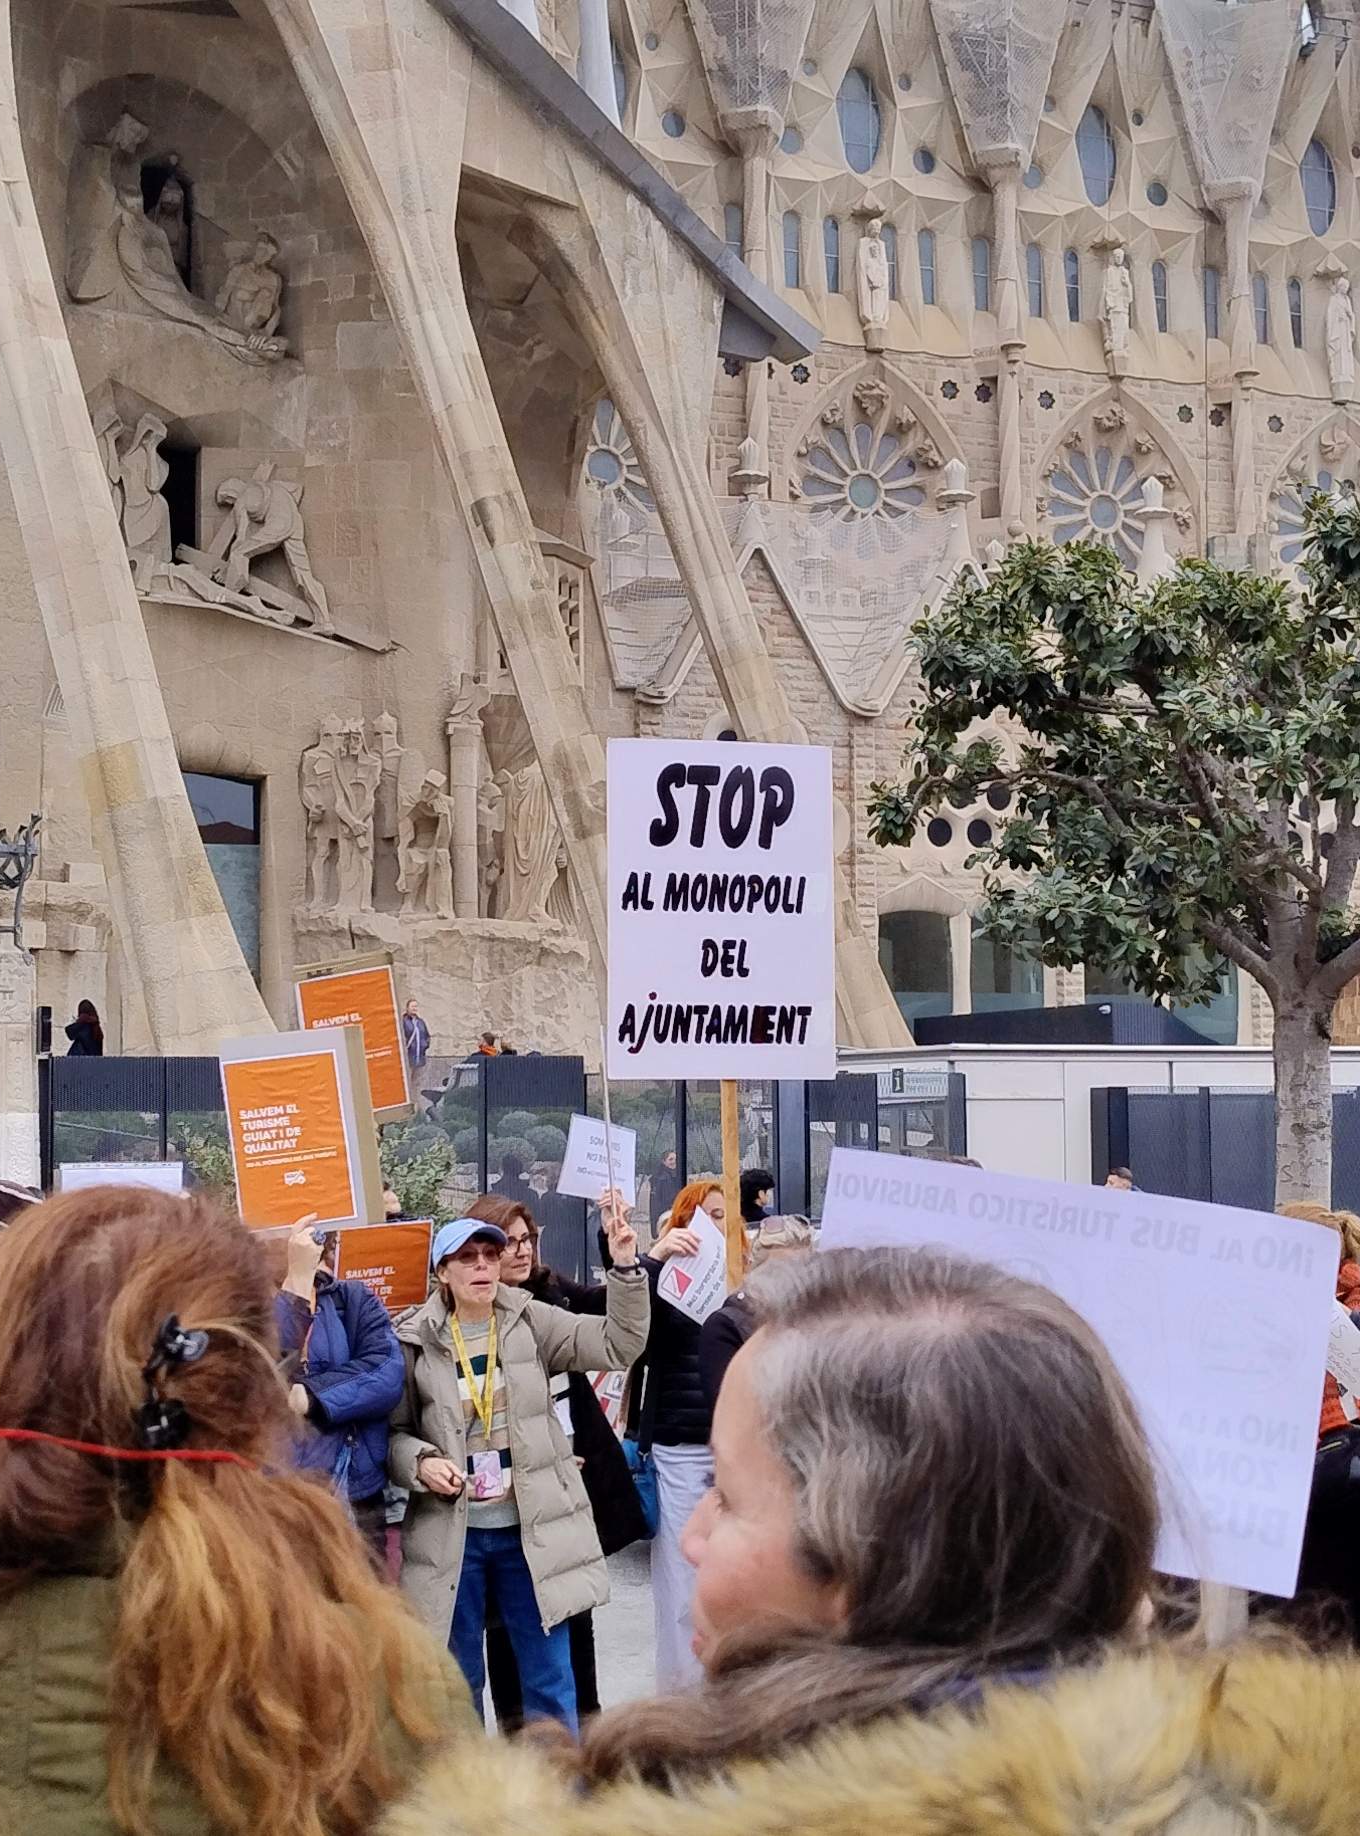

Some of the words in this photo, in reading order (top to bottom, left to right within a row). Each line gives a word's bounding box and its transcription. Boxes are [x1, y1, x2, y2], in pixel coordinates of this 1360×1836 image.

[649, 762, 795, 850] STOP
[621, 871, 655, 912] AL
[662, 872, 806, 914] MONOPOLI
[700, 938, 750, 978] DEL
[239, 1105, 285, 1120] SALVEM
[285, 1104, 301, 1114] EL
[240, 1116, 291, 1131] TURISME
[242, 1129, 278, 1143] GUIAT
[285, 1126, 301, 1137] DE
[243, 1138, 298, 1155] QUALITAT
